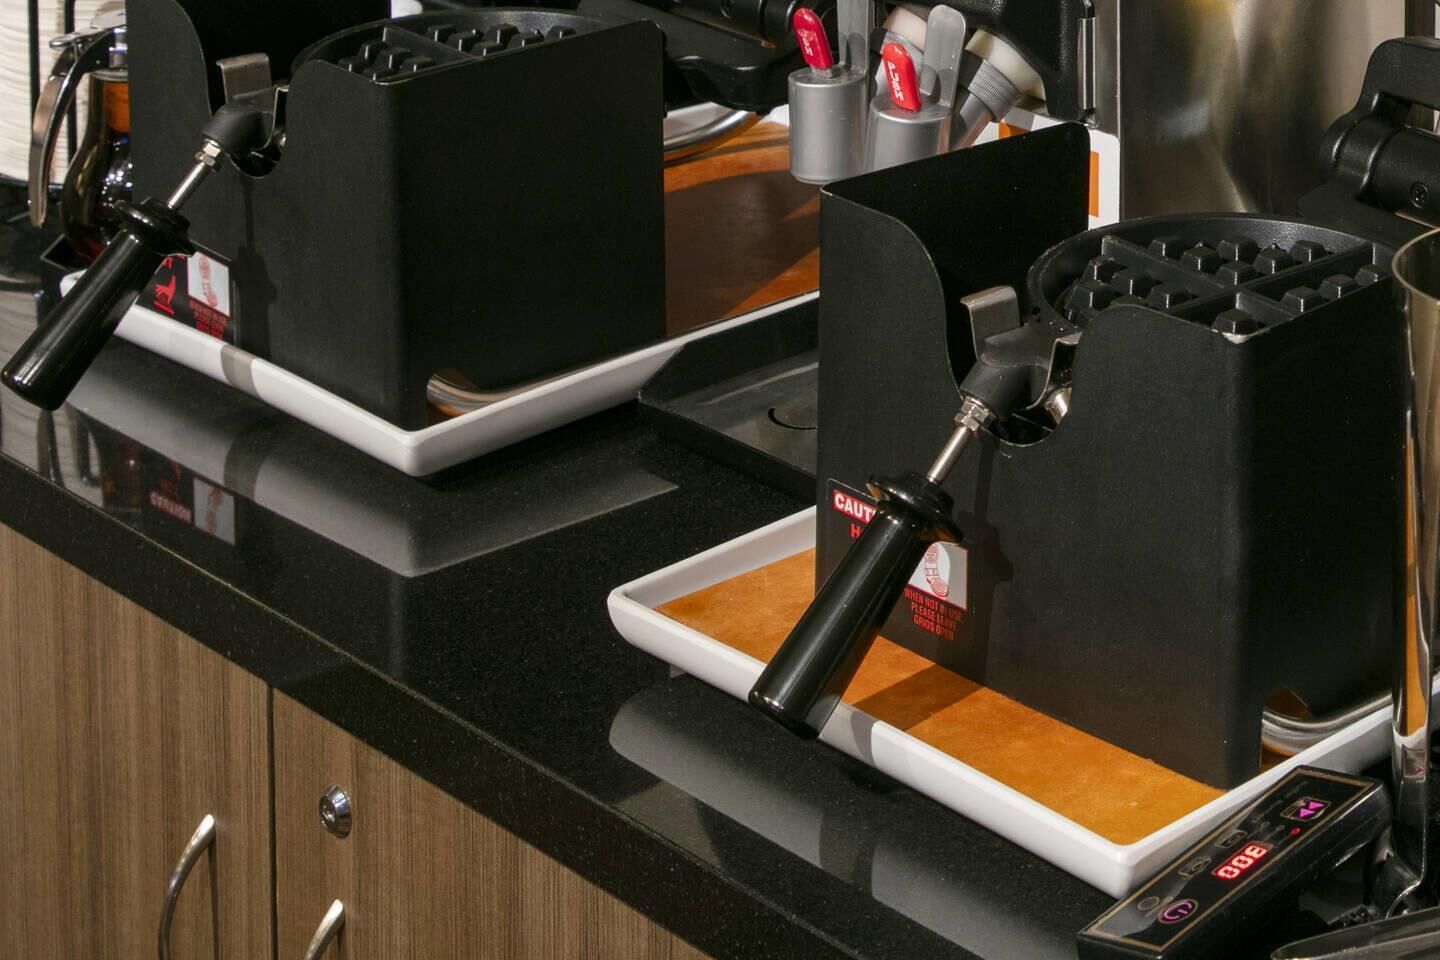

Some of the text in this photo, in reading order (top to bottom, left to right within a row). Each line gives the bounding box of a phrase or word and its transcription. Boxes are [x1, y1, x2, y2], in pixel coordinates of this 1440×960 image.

[887, 60, 904, 101] PUSH
[834, 493, 877, 522] CAUT
[904, 588, 924, 605] WHEN
[925, 597, 939, 611] NOT
[911, 602, 936, 621] PLEASE
[913, 614, 935, 633] GRIDS
